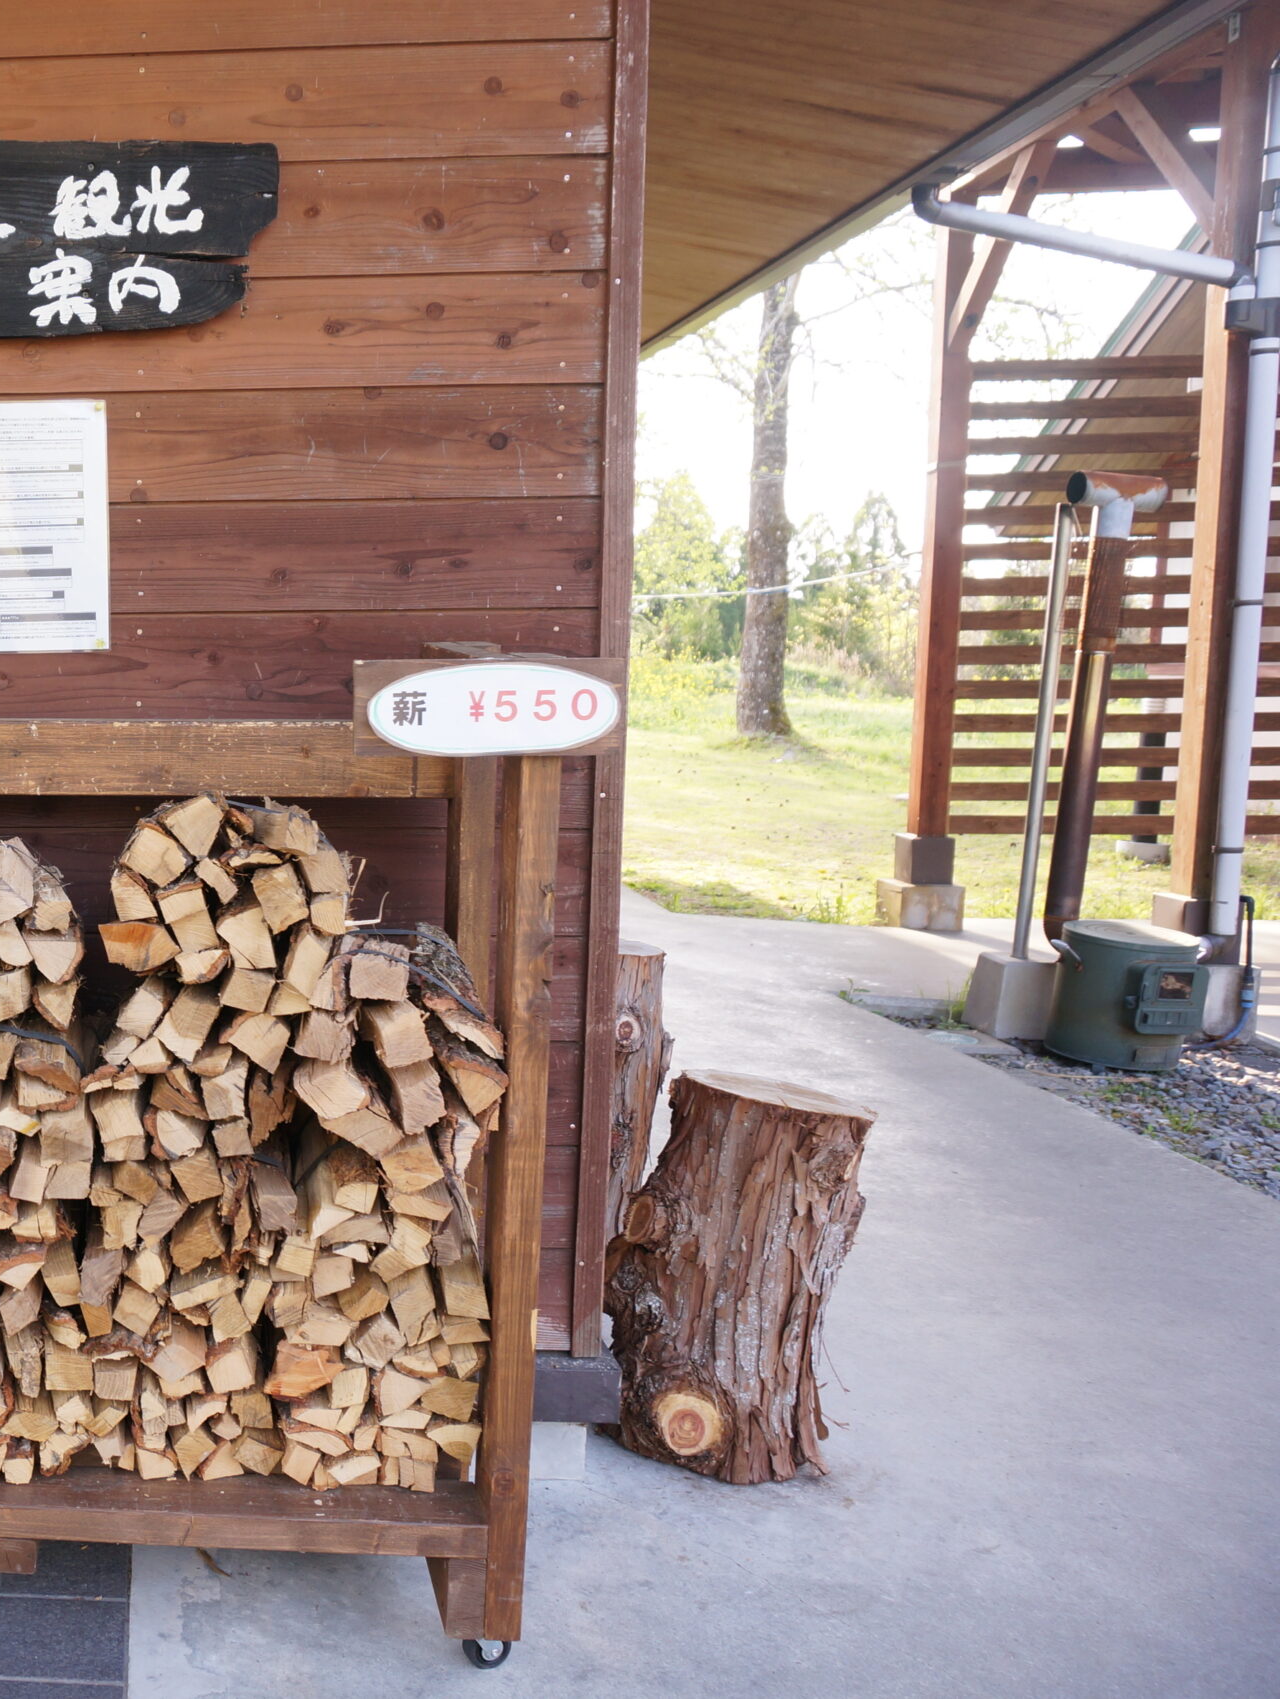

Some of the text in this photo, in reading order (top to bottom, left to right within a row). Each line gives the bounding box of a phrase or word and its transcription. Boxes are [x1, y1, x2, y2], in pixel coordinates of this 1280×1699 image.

[53, 165, 205, 240] 観光
[27, 248, 182, 326] 案内
[392, 688, 599, 727] 薪 ¥550
